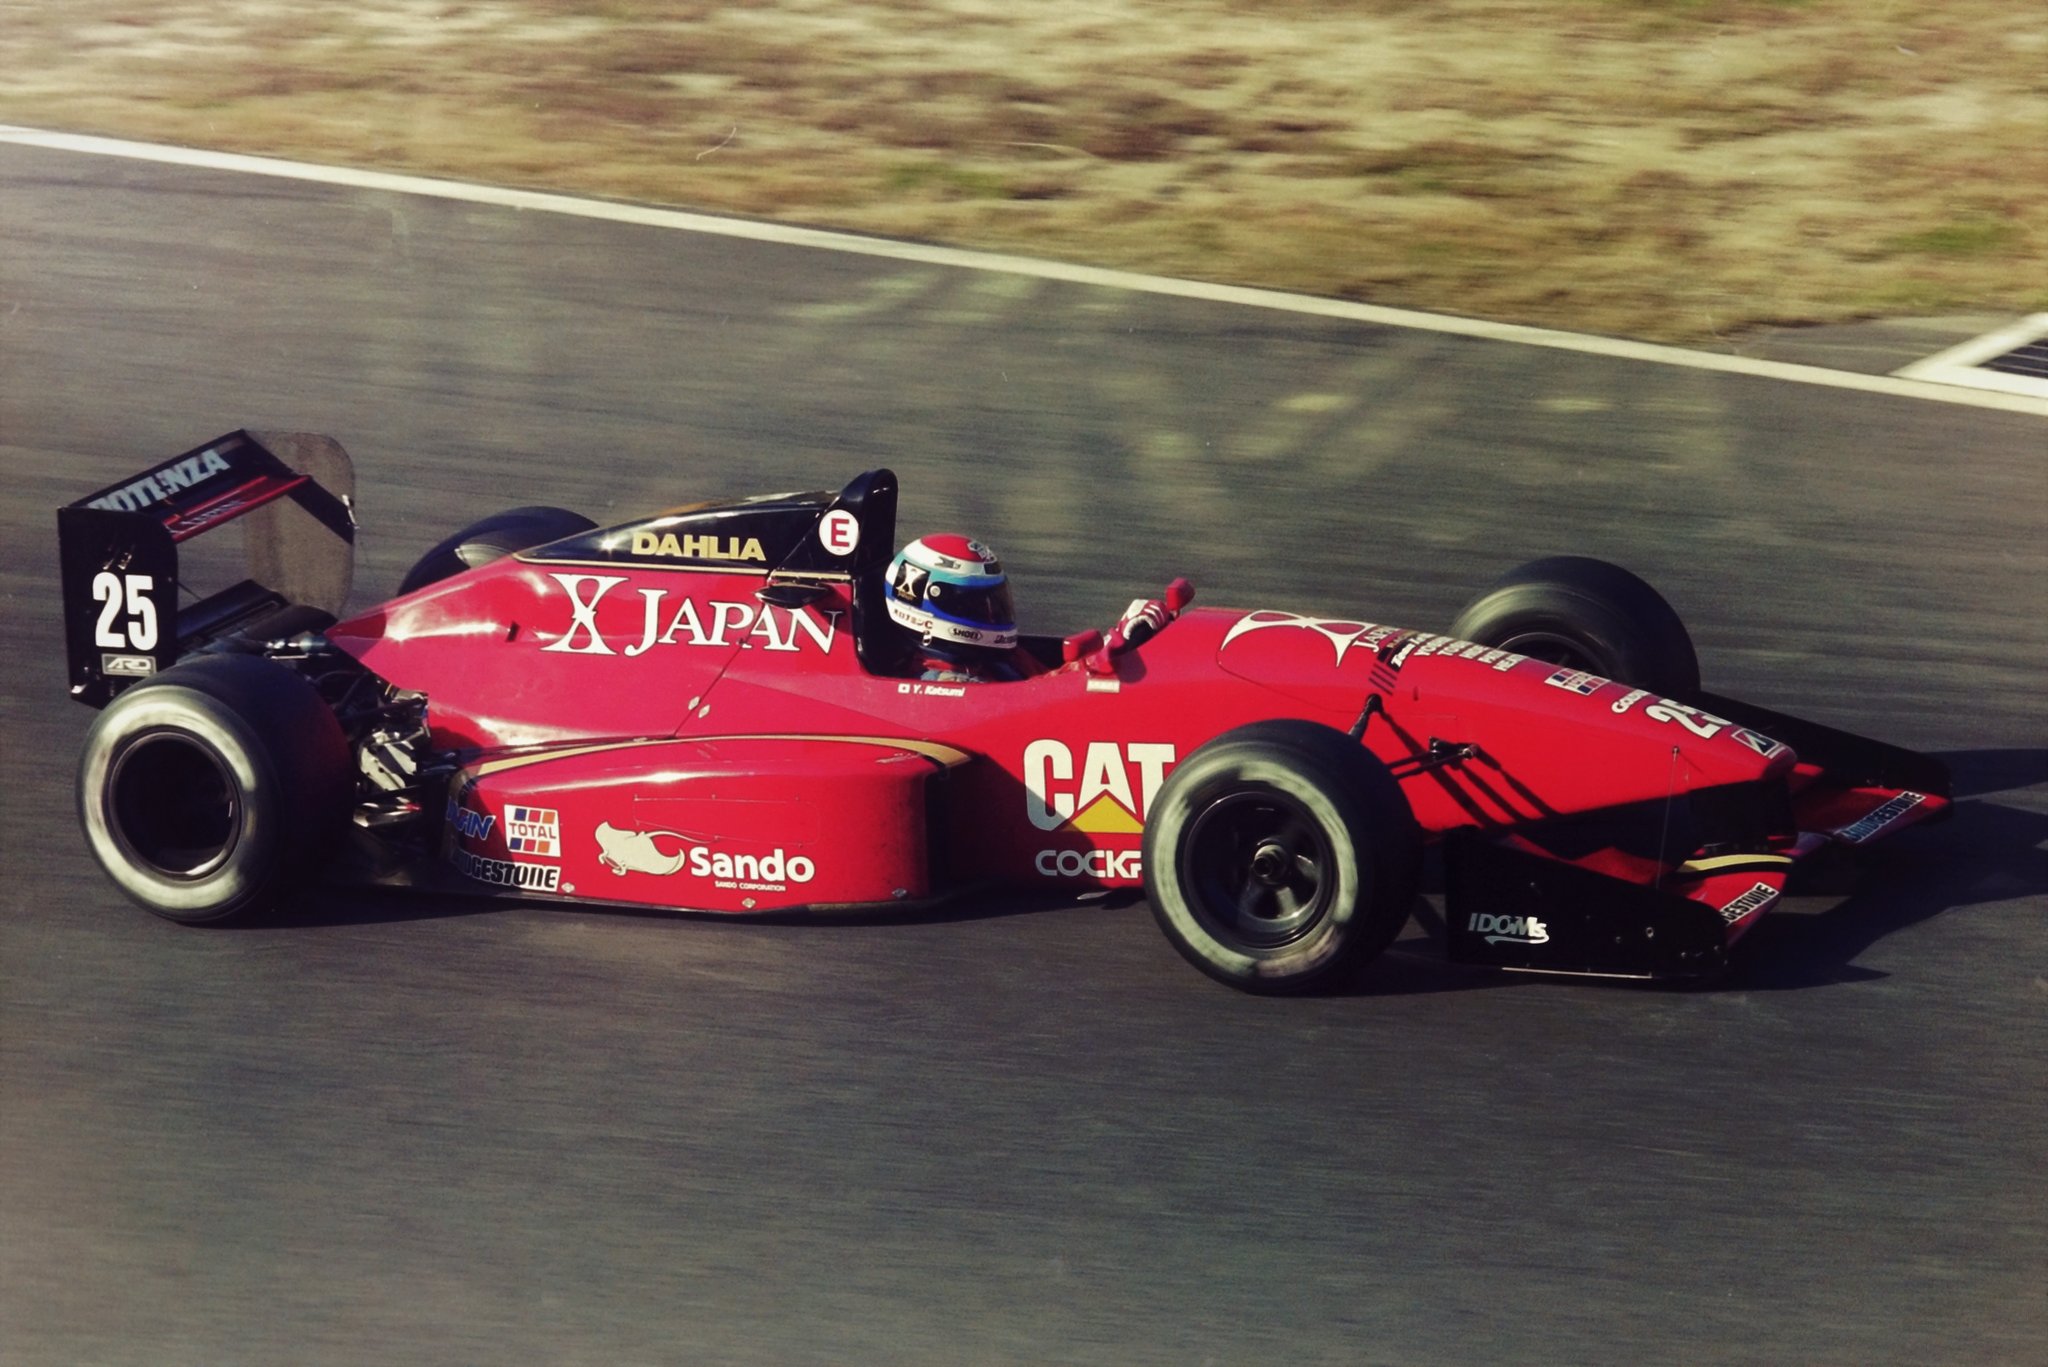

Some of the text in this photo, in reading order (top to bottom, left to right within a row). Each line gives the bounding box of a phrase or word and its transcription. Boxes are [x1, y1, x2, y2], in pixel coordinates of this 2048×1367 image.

[631, 532, 766, 561] DAHLIA
[830, 518, 850, 547] E
[92, 571, 158, 650] 25
[540, 573, 844, 656] X JAPAN
[913, 684, 923, 695] Y.
[1023, 738, 1176, 832] CAT
[508, 822, 557, 840] TOTAL
[689, 846, 815, 883] Sando
[715, 880, 786, 892] SANDO CORPORATION
[1720, 883, 1777, 922] GESTONE
